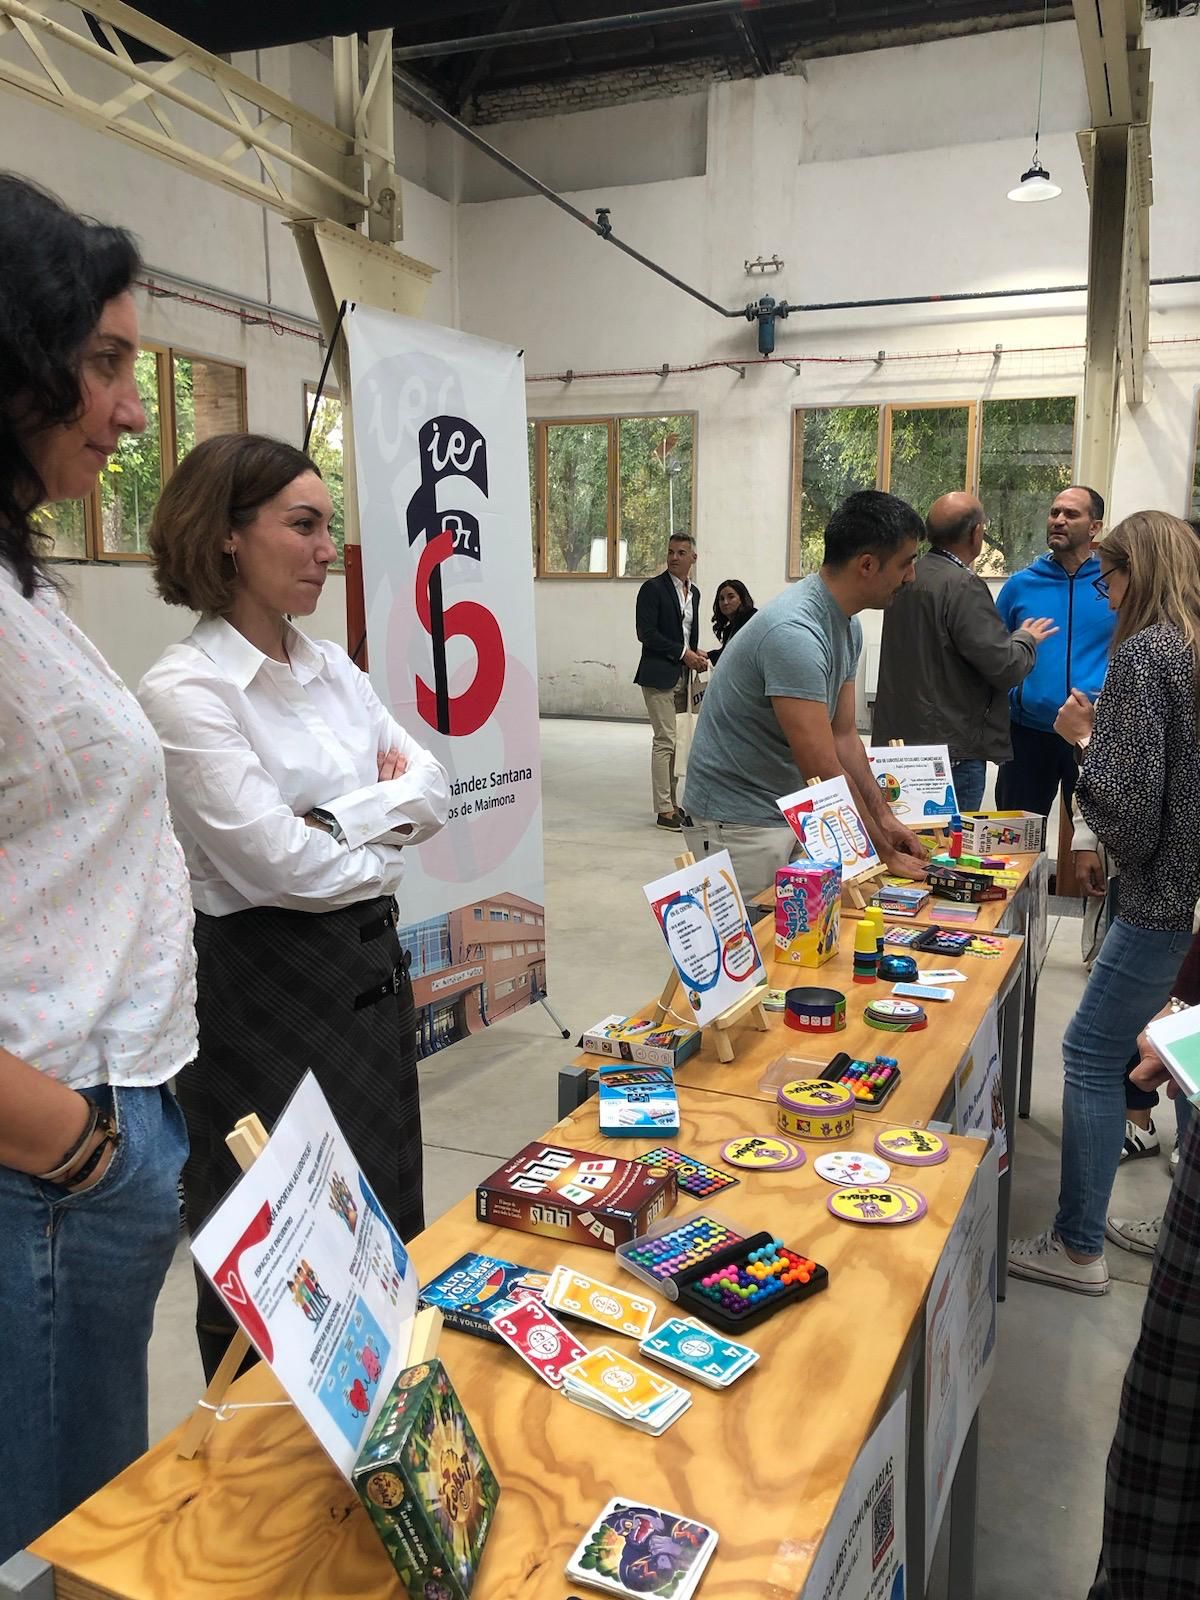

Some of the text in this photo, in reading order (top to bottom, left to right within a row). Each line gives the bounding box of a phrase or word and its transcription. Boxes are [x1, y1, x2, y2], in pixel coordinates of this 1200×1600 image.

[427, 422, 482, 472] ies
[449, 767, 532, 796] nández Santana
[448, 793, 515, 819] os de Maimona
[794, 887, 810, 932] Speed
[783, 900, 797, 940] Cups
[674, 1162, 697, 1178] IQ
[274, 1178, 294, 1214] APORTAN
[290, 1168, 299, 1185] LAS
[531, 1205, 569, 1227] SET
[253, 1213, 294, 1280] ESPACIO DE ENCUENTRO
[436, 1271, 467, 1293] ALTO
[444, 1260, 495, 1300] VOLTAJE
[573, 1277, 590, 1289] 8
[526, 1304, 544, 1319] 3
[563, 1298, 581, 1310] 8
[631, 1301, 648, 1313] 8
[309, 1298, 341, 1366] BIENESTAR EMOCIONAL
[460, 1317, 495, 1333] VOLTAGE
[500, 1319, 518, 1335] 3
[622, 1322, 640, 1334] 8
[669, 1323, 688, 1334] 4
[650, 1338, 670, 1350] 4
[722, 1346, 744, 1357] 4
[599, 1350, 616, 1362] 7
[543, 1364, 562, 1381] 3
[570, 1366, 588, 1377] 7
[703, 1362, 724, 1376] 4
[649, 1380, 667, 1393] 7
[623, 1396, 641, 1410] 7
[848, 1456, 894, 1546] COMUNITARIAS
